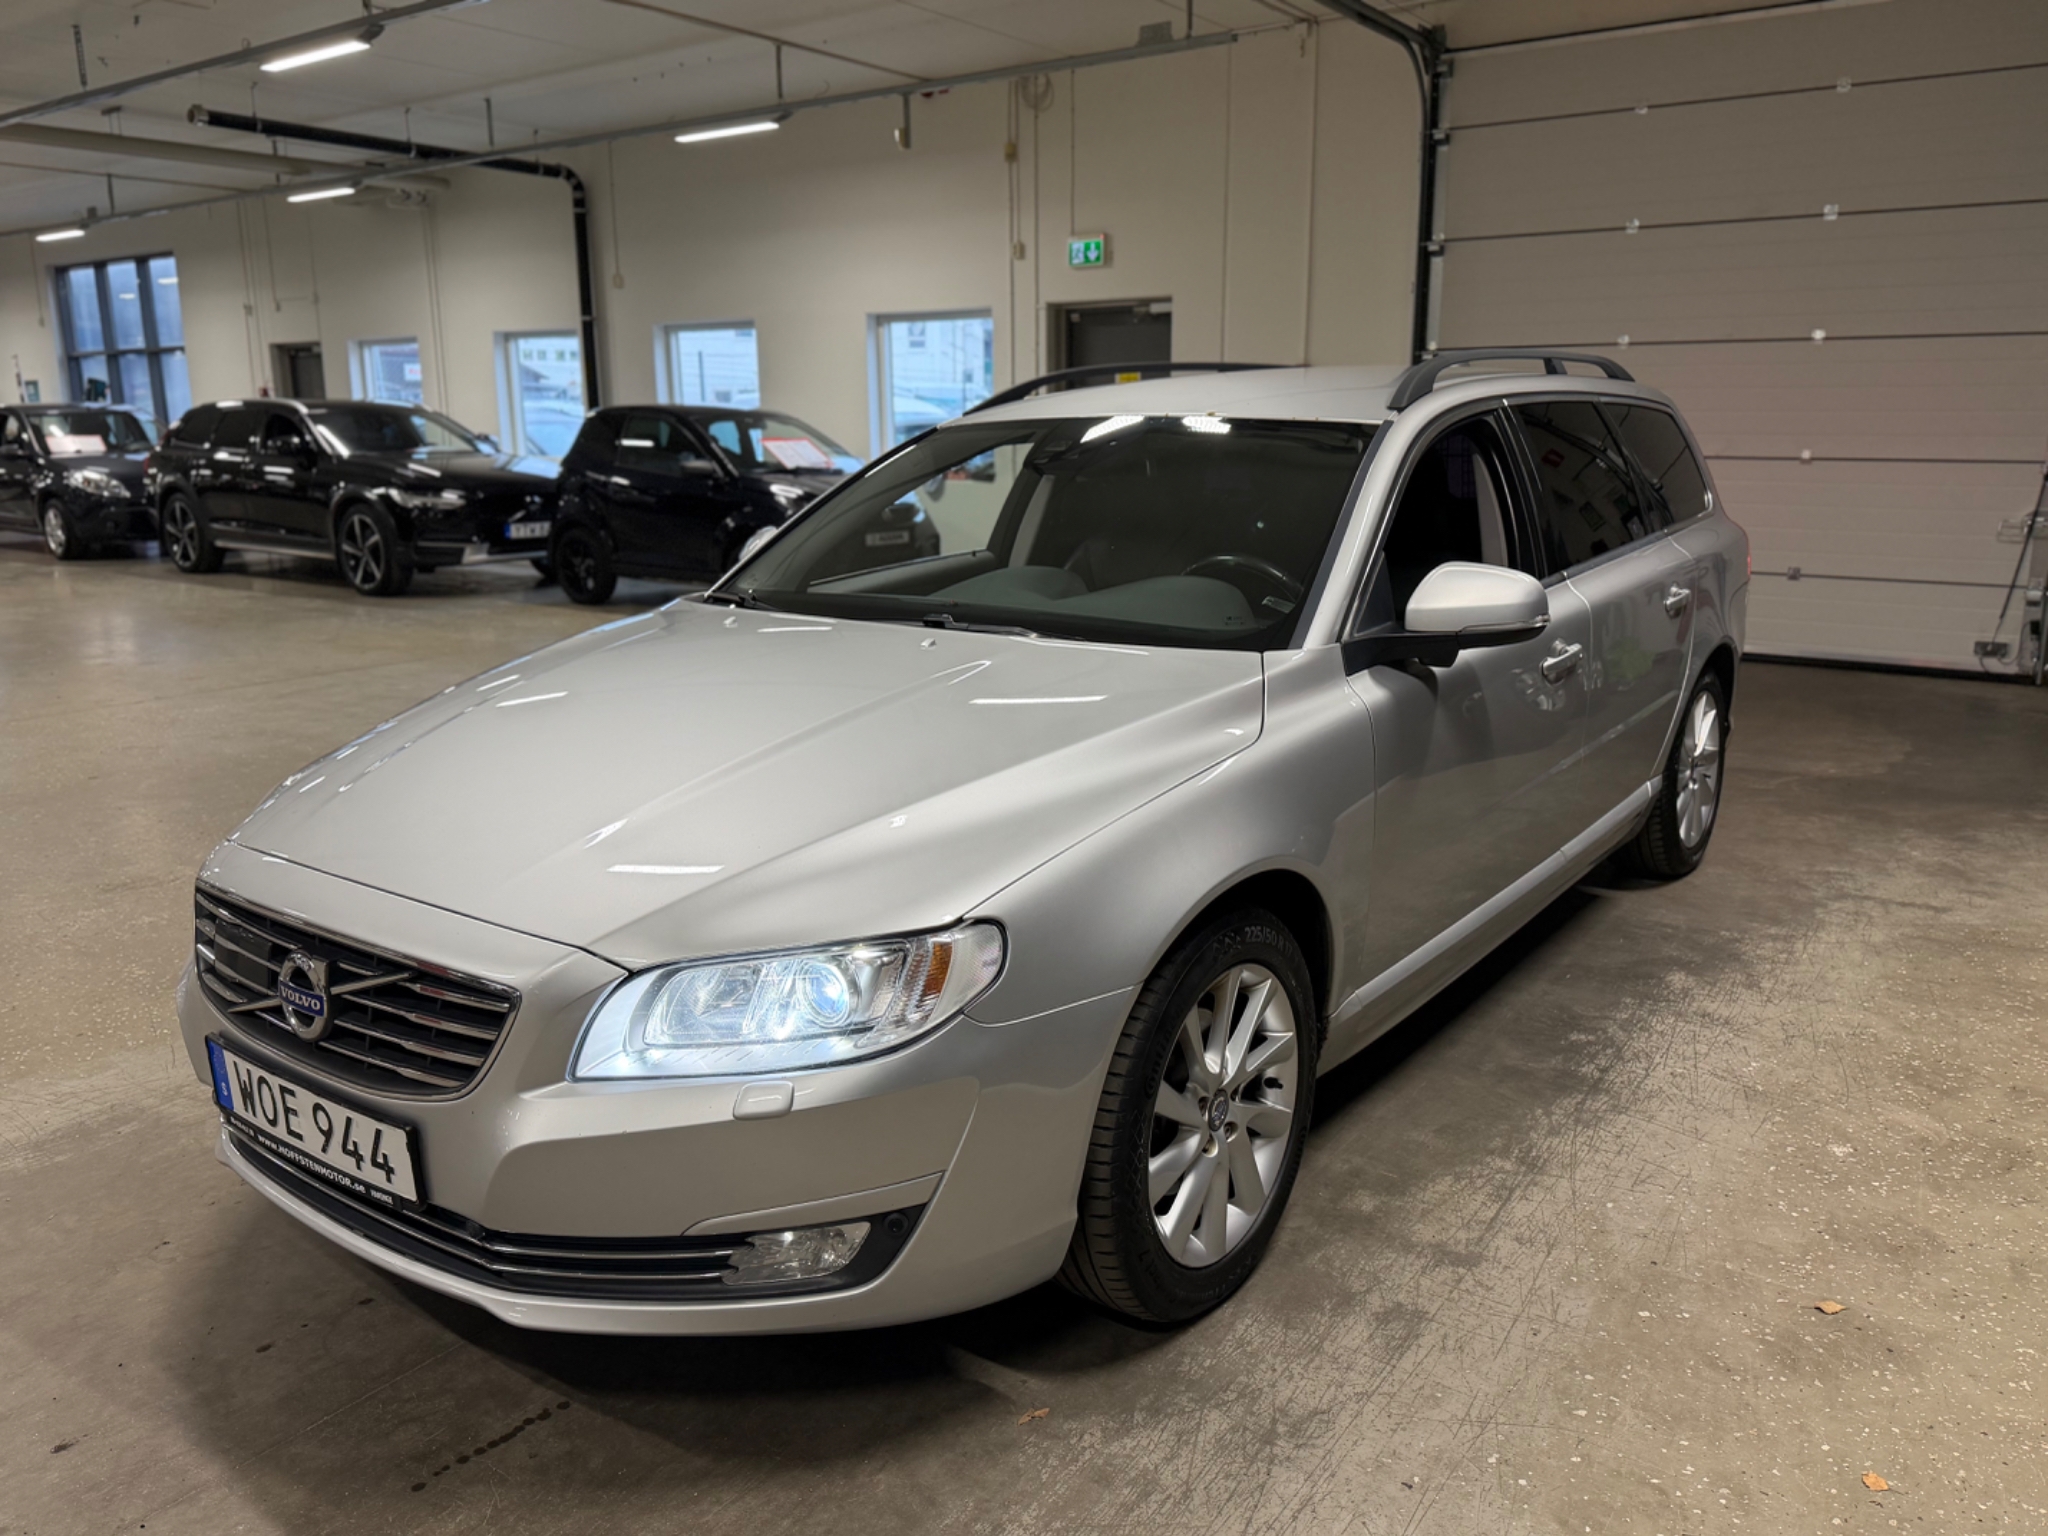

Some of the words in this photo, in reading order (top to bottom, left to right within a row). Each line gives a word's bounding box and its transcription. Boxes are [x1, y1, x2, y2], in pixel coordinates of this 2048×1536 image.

[1244, 925, 1278, 946] 225/50
[280, 985, 321, 1010] VOLVO
[233, 1060, 304, 1142] WOE
[312, 1102, 395, 1184] 944
